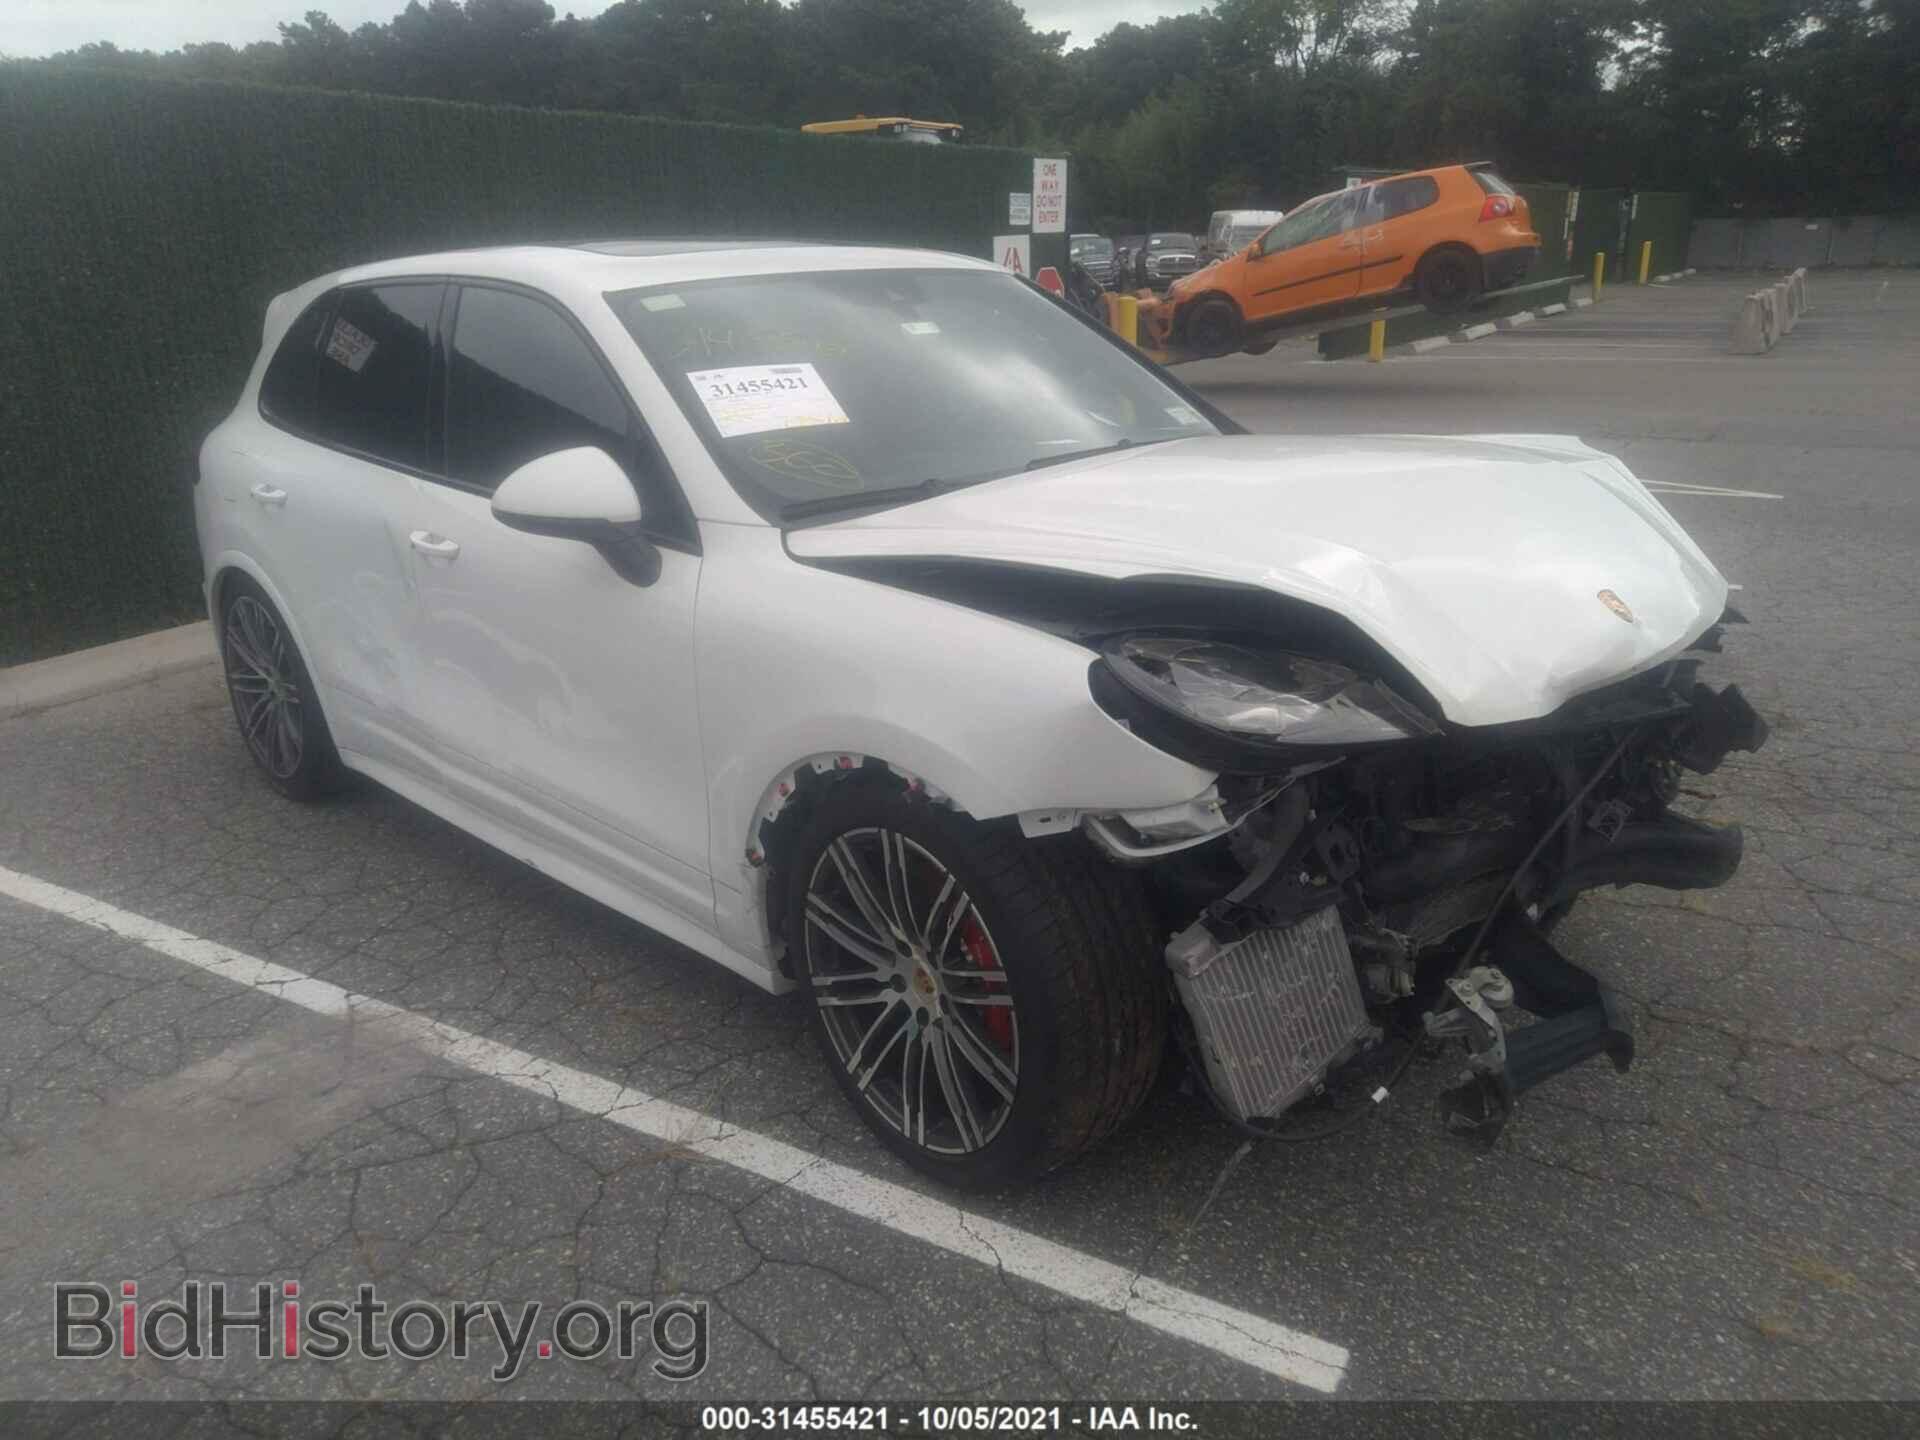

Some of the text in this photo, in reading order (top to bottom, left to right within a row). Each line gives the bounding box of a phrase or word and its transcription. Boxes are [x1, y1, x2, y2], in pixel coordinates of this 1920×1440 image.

[1041, 180, 1060, 193] WAY
[1036, 195, 1047, 208] DO
[1047, 194, 1062, 208] NOT
[1038, 211, 1060, 224] ENTER
[709, 376, 810, 398] 31455421
